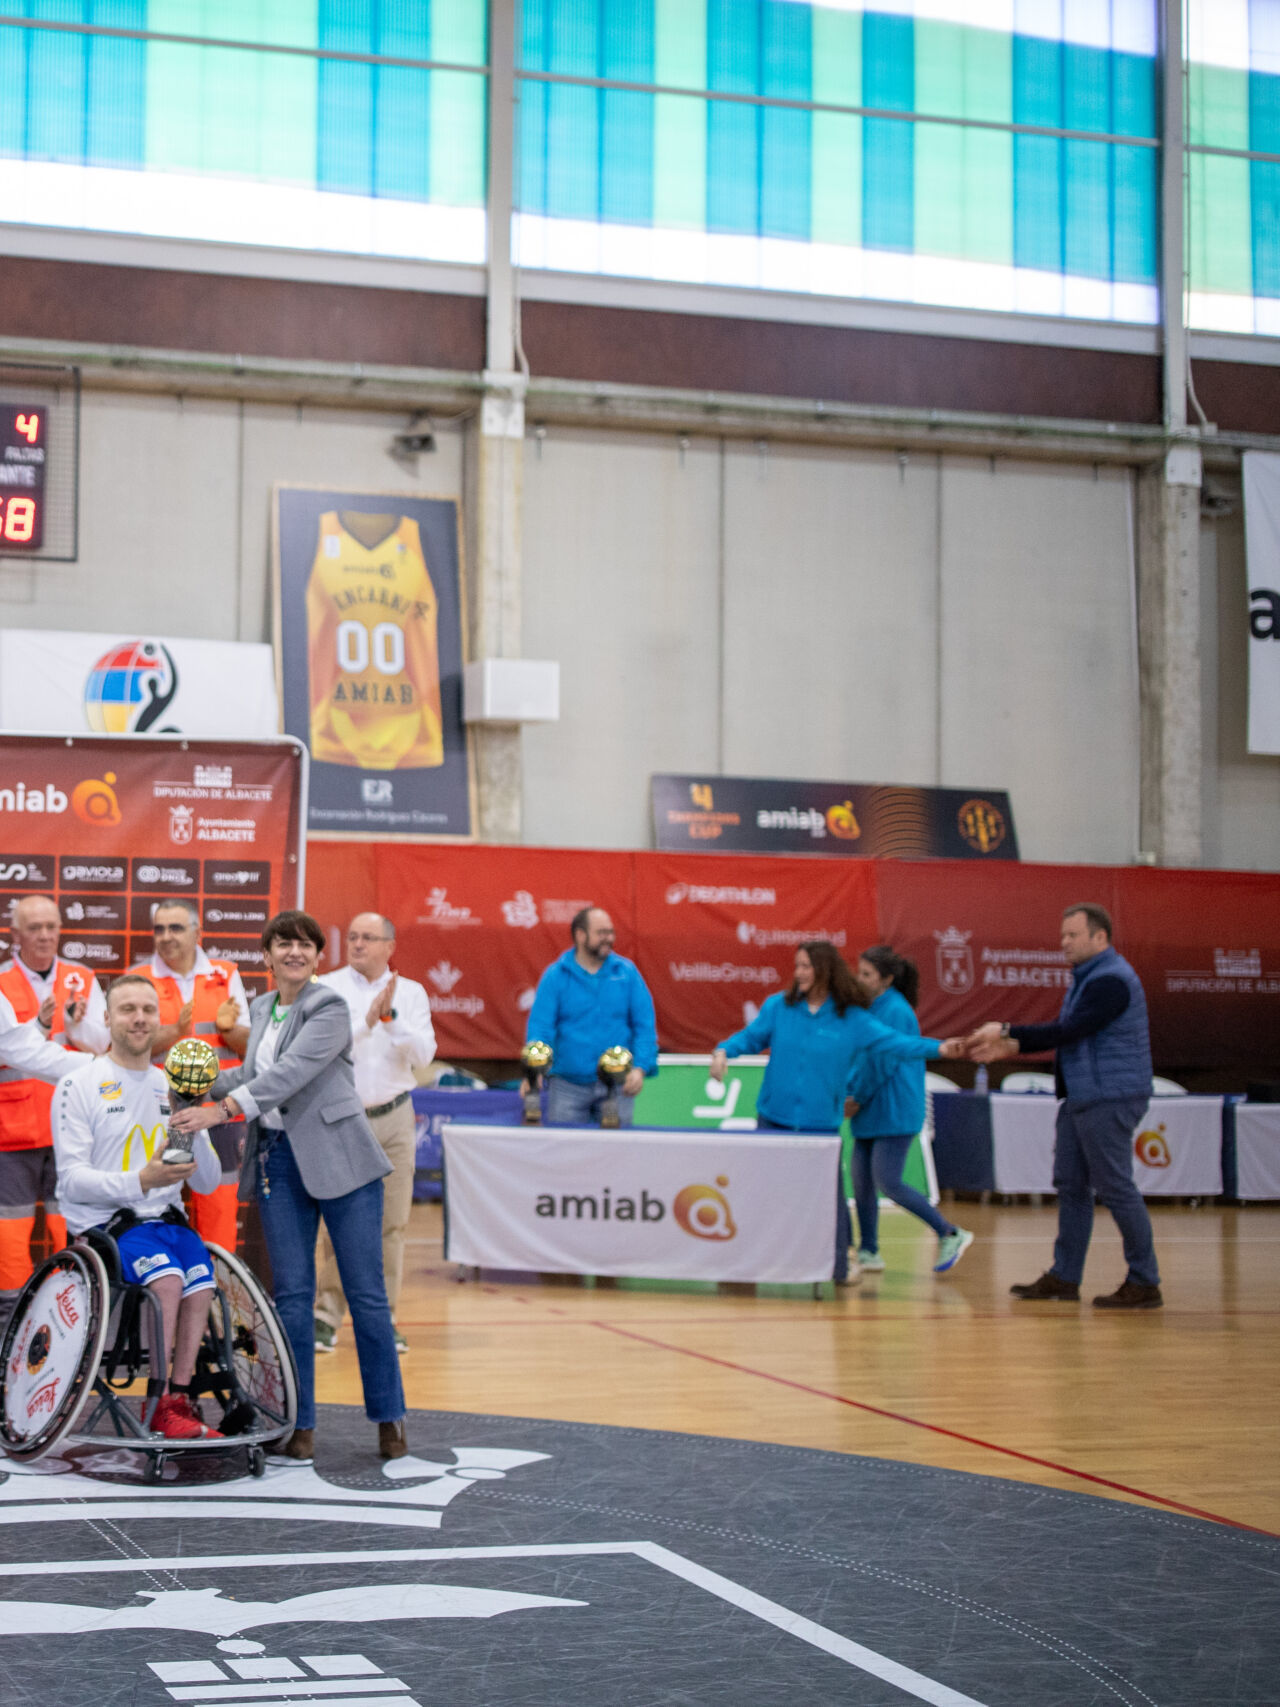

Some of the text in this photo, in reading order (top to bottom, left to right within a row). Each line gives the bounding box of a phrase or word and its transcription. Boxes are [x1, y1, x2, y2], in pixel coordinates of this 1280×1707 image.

[15, 414, 39, 443] 4
[337, 620, 405, 675] 00
[334, 682, 413, 704] AMIAB
[154, 786, 272, 801] DIPUTACIÓN DE ALBACETE
[757, 807, 826, 829] amiab
[197, 829, 256, 842] ALBACETE
[535, 1187, 666, 1223] amiab
[56, 1284, 79, 1330] Leica
[27, 1377, 61, 1418] Leica
